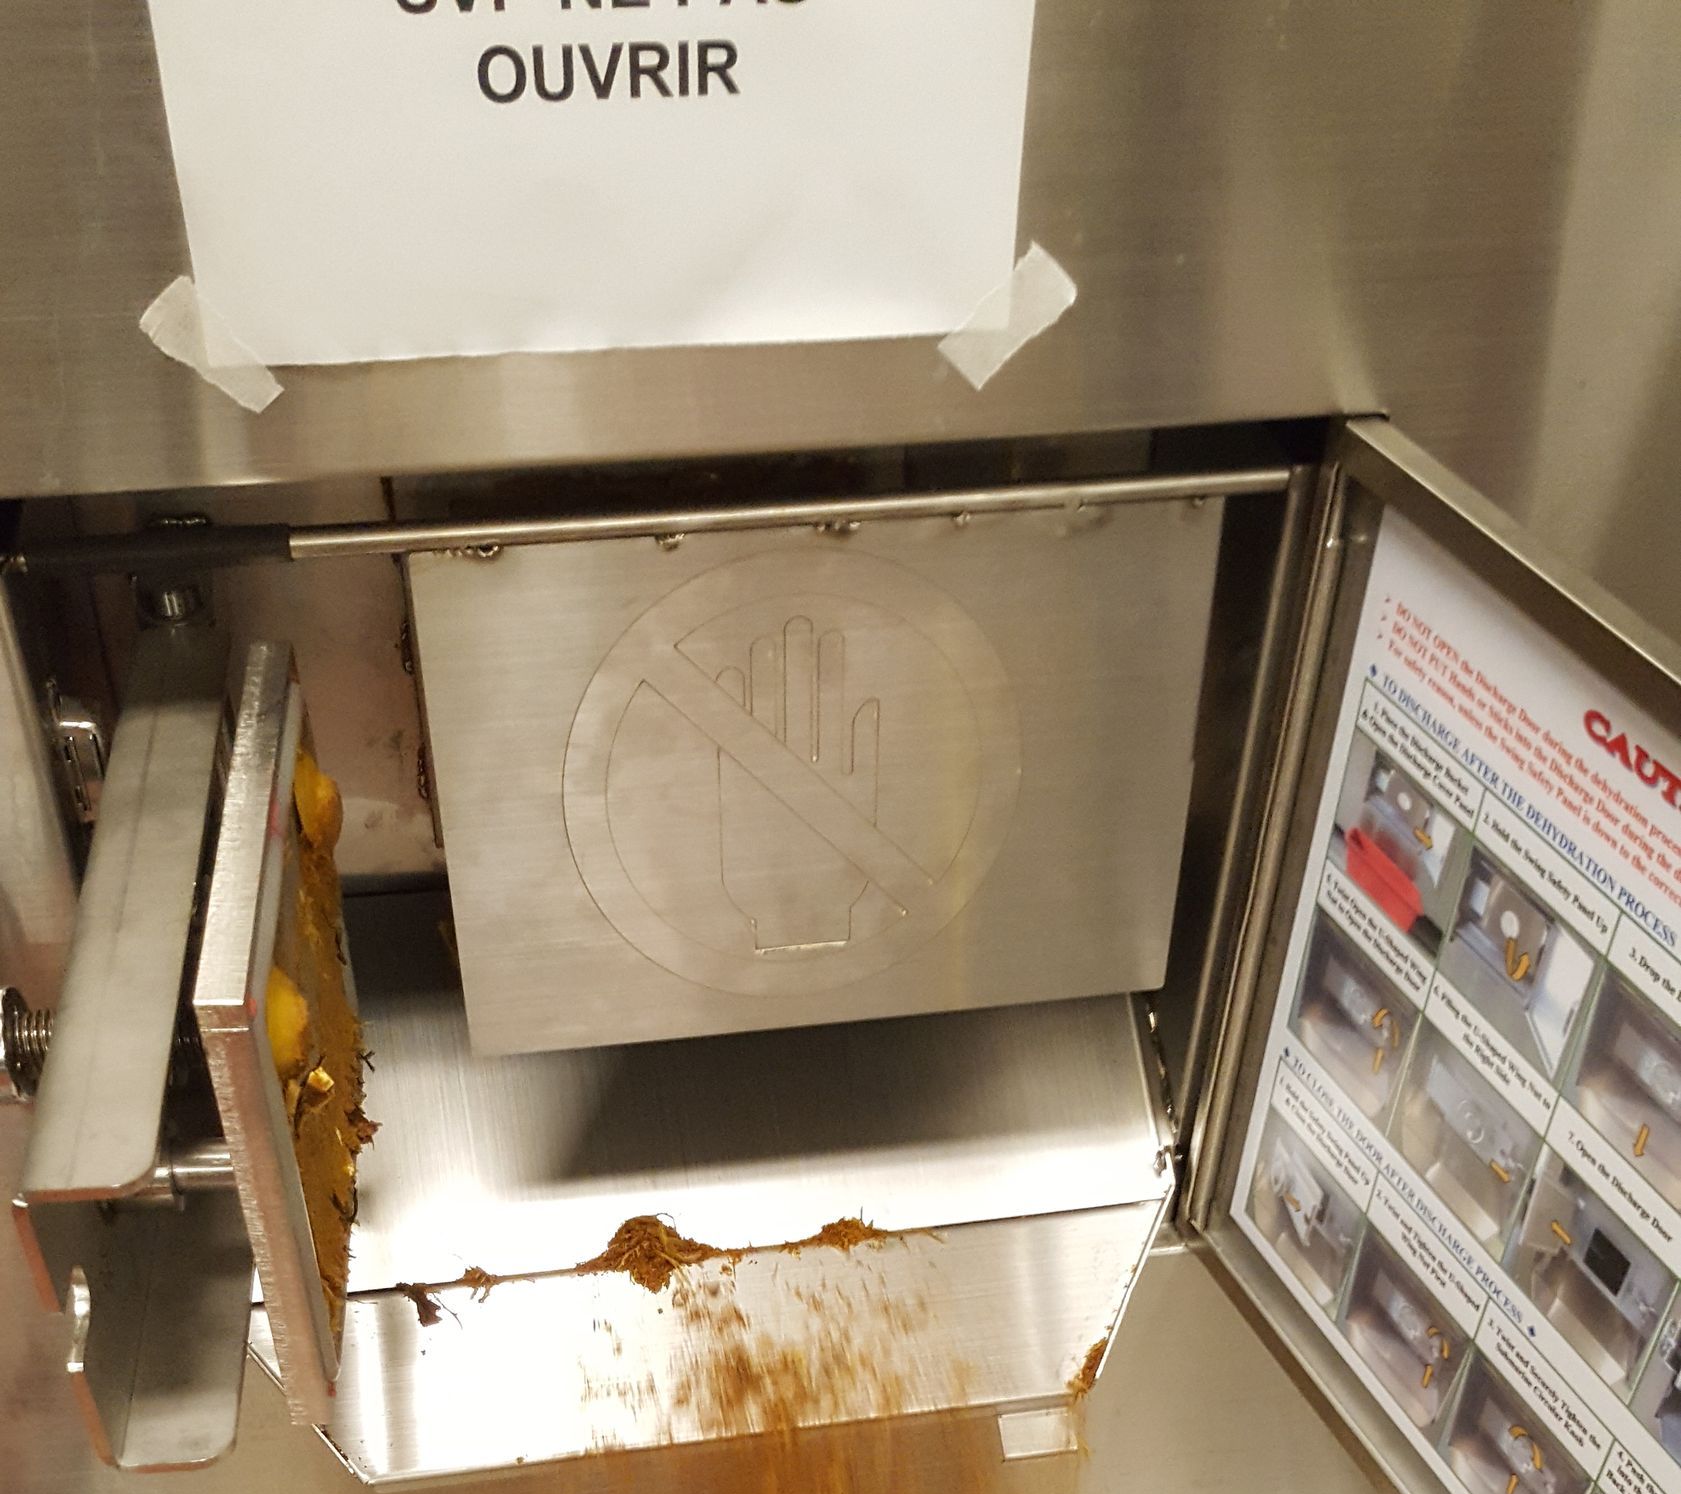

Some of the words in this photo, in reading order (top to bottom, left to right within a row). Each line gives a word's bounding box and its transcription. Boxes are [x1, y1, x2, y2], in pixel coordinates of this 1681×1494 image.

[477, 39, 740, 104] OUVRIR
[1402, 651, 1426, 681] safety
[1483, 723, 1498, 745] the
[1498, 736, 1526, 769] Swing
[1525, 761, 1554, 795] Safety
[1554, 786, 1581, 819] Panel
[1590, 818, 1618, 851] down
[1629, 853, 1647, 877] the
[1407, 633, 1426, 660] NOT
[1448, 669, 1475, 703] Hands
[1513, 727, 1532, 752] into
[1532, 744, 1548, 766] the
[1548, 758, 1594, 807] Discharge
[1594, 798, 1620, 829] Door
[1619, 820, 1655, 860] during
[1654, 851, 1671, 874] the
[1411, 614, 1431, 641] NOT
[1459, 656, 1474, 678] the
[1474, 668, 1518, 716] Discharge
[1517, 705, 1541, 736] Door
[1541, 726, 1574, 765] during
[1573, 754, 1590, 778] the
[1589, 768, 1649, 830] dehydration
[1648, 819, 1681, 859] proces
[1583, 709, 1681, 812] CAUT
[1398, 687, 1458, 751] DISCHARGE
[1461, 744, 1499, 787] AFTER
[1501, 780, 1526, 812] THE
[1525, 803, 1616, 893] DEHYDRATION
[1617, 885, 1677, 948] PROCESS
[1509, 836, 1522, 856] the
[1522, 848, 1546, 878] Swing
[1546, 870, 1571, 902] Safety
[1571, 894, 1594, 923] Panel
[1637, 955, 1661, 984] Drop
[1660, 976, 1677, 999] the
[1383, 1159, 1415, 1201] AFTER
[1415, 1195, 1474, 1268] DISCHARGE
[1474, 1263, 1523, 1325] PROCESS
[1575, 1138, 1597, 1166] Open
[1596, 1161, 1611, 1181] the
[1610, 1175, 1650, 1221] Discharge
[1650, 1216, 1673, 1244] Door
[1495, 1326, 1515, 1353] Twist
[1514, 1348, 1529, 1369] and
[1529, 1364, 1559, 1404] Securely
[1559, 1399, 1588, 1437] Tighten
[1588, 1432, 1601, 1451] the
[1532, 1384, 1563, 1424] Circular
[1563, 1419, 1584, 1448] Knob
[1606, 1467, 1626, 1494] Back
[1625, 1457, 1646, 1484] Push
